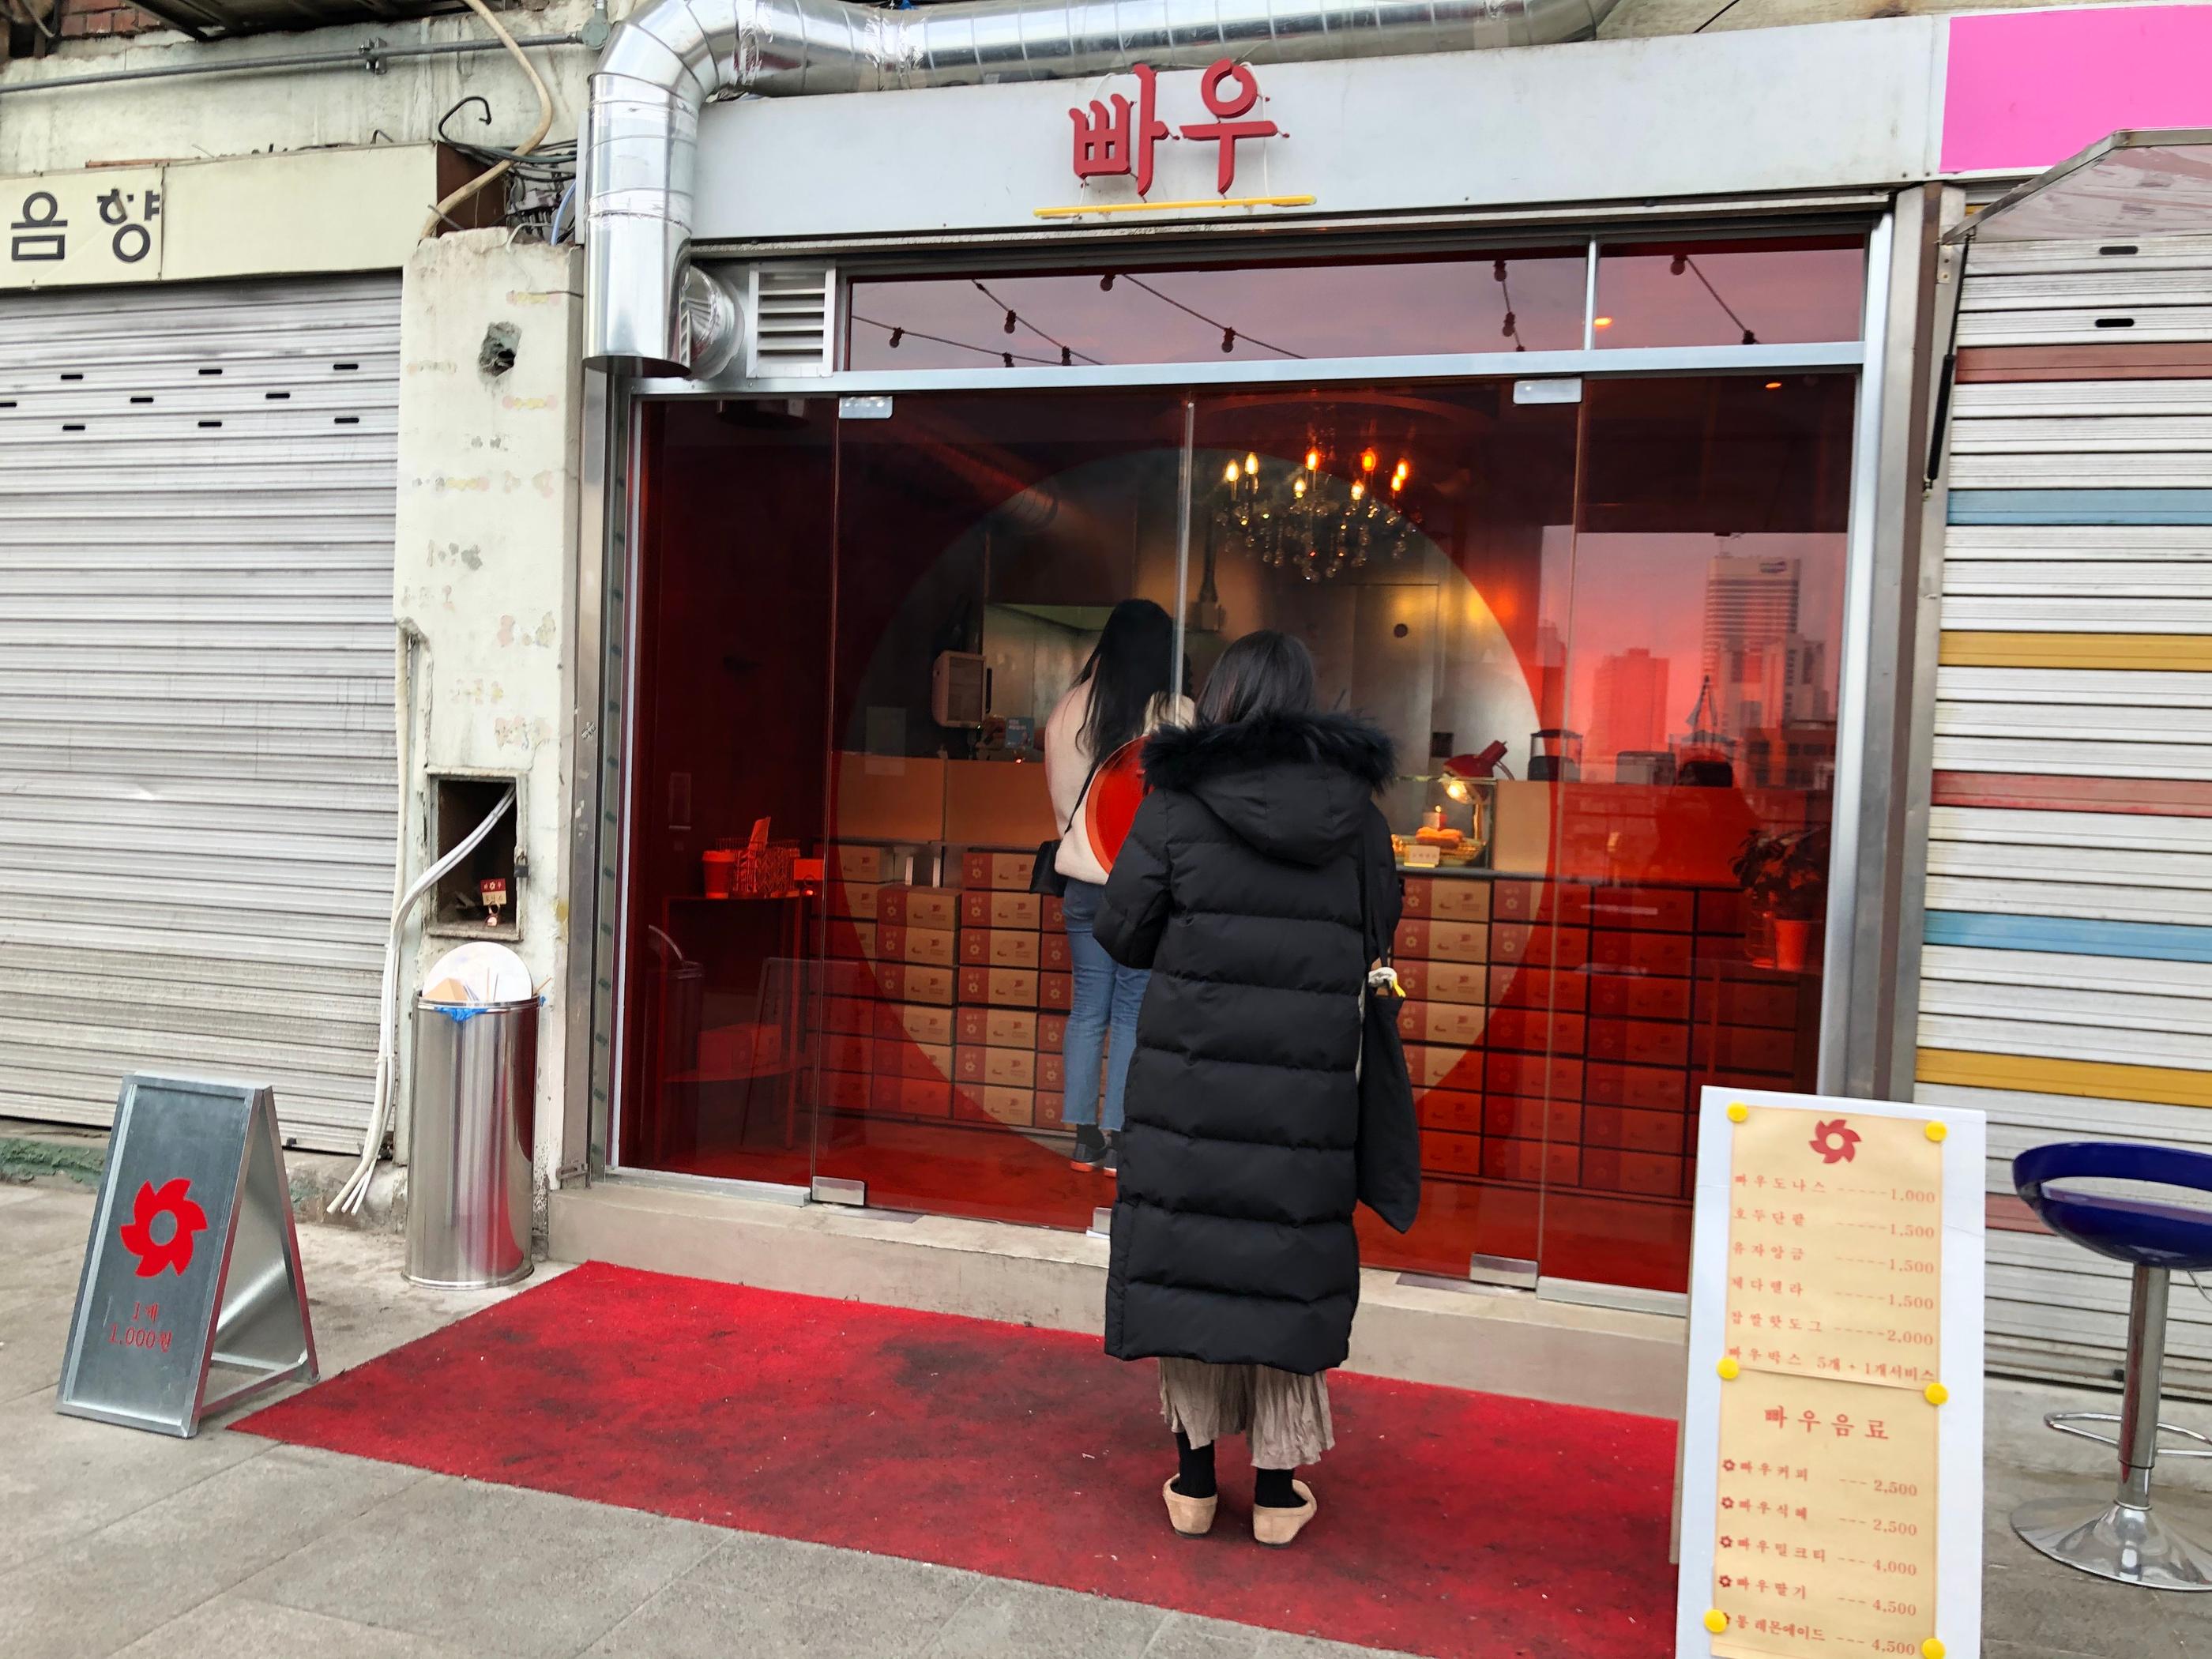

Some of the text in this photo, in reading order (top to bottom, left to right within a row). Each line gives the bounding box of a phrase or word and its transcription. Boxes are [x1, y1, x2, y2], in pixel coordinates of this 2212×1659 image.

[1068, 58, 1280, 196] 빠우
[1764, 1405, 1890, 1440] 빠우음료
[1740, 1460, 1808, 1482] 빠우커피
[1736, 1537, 1826, 1563] 빠우밀크티
[1736, 1576, 1807, 1600] 빠우딸기
[1755, 1618, 1826, 1642] 레몬에이드
